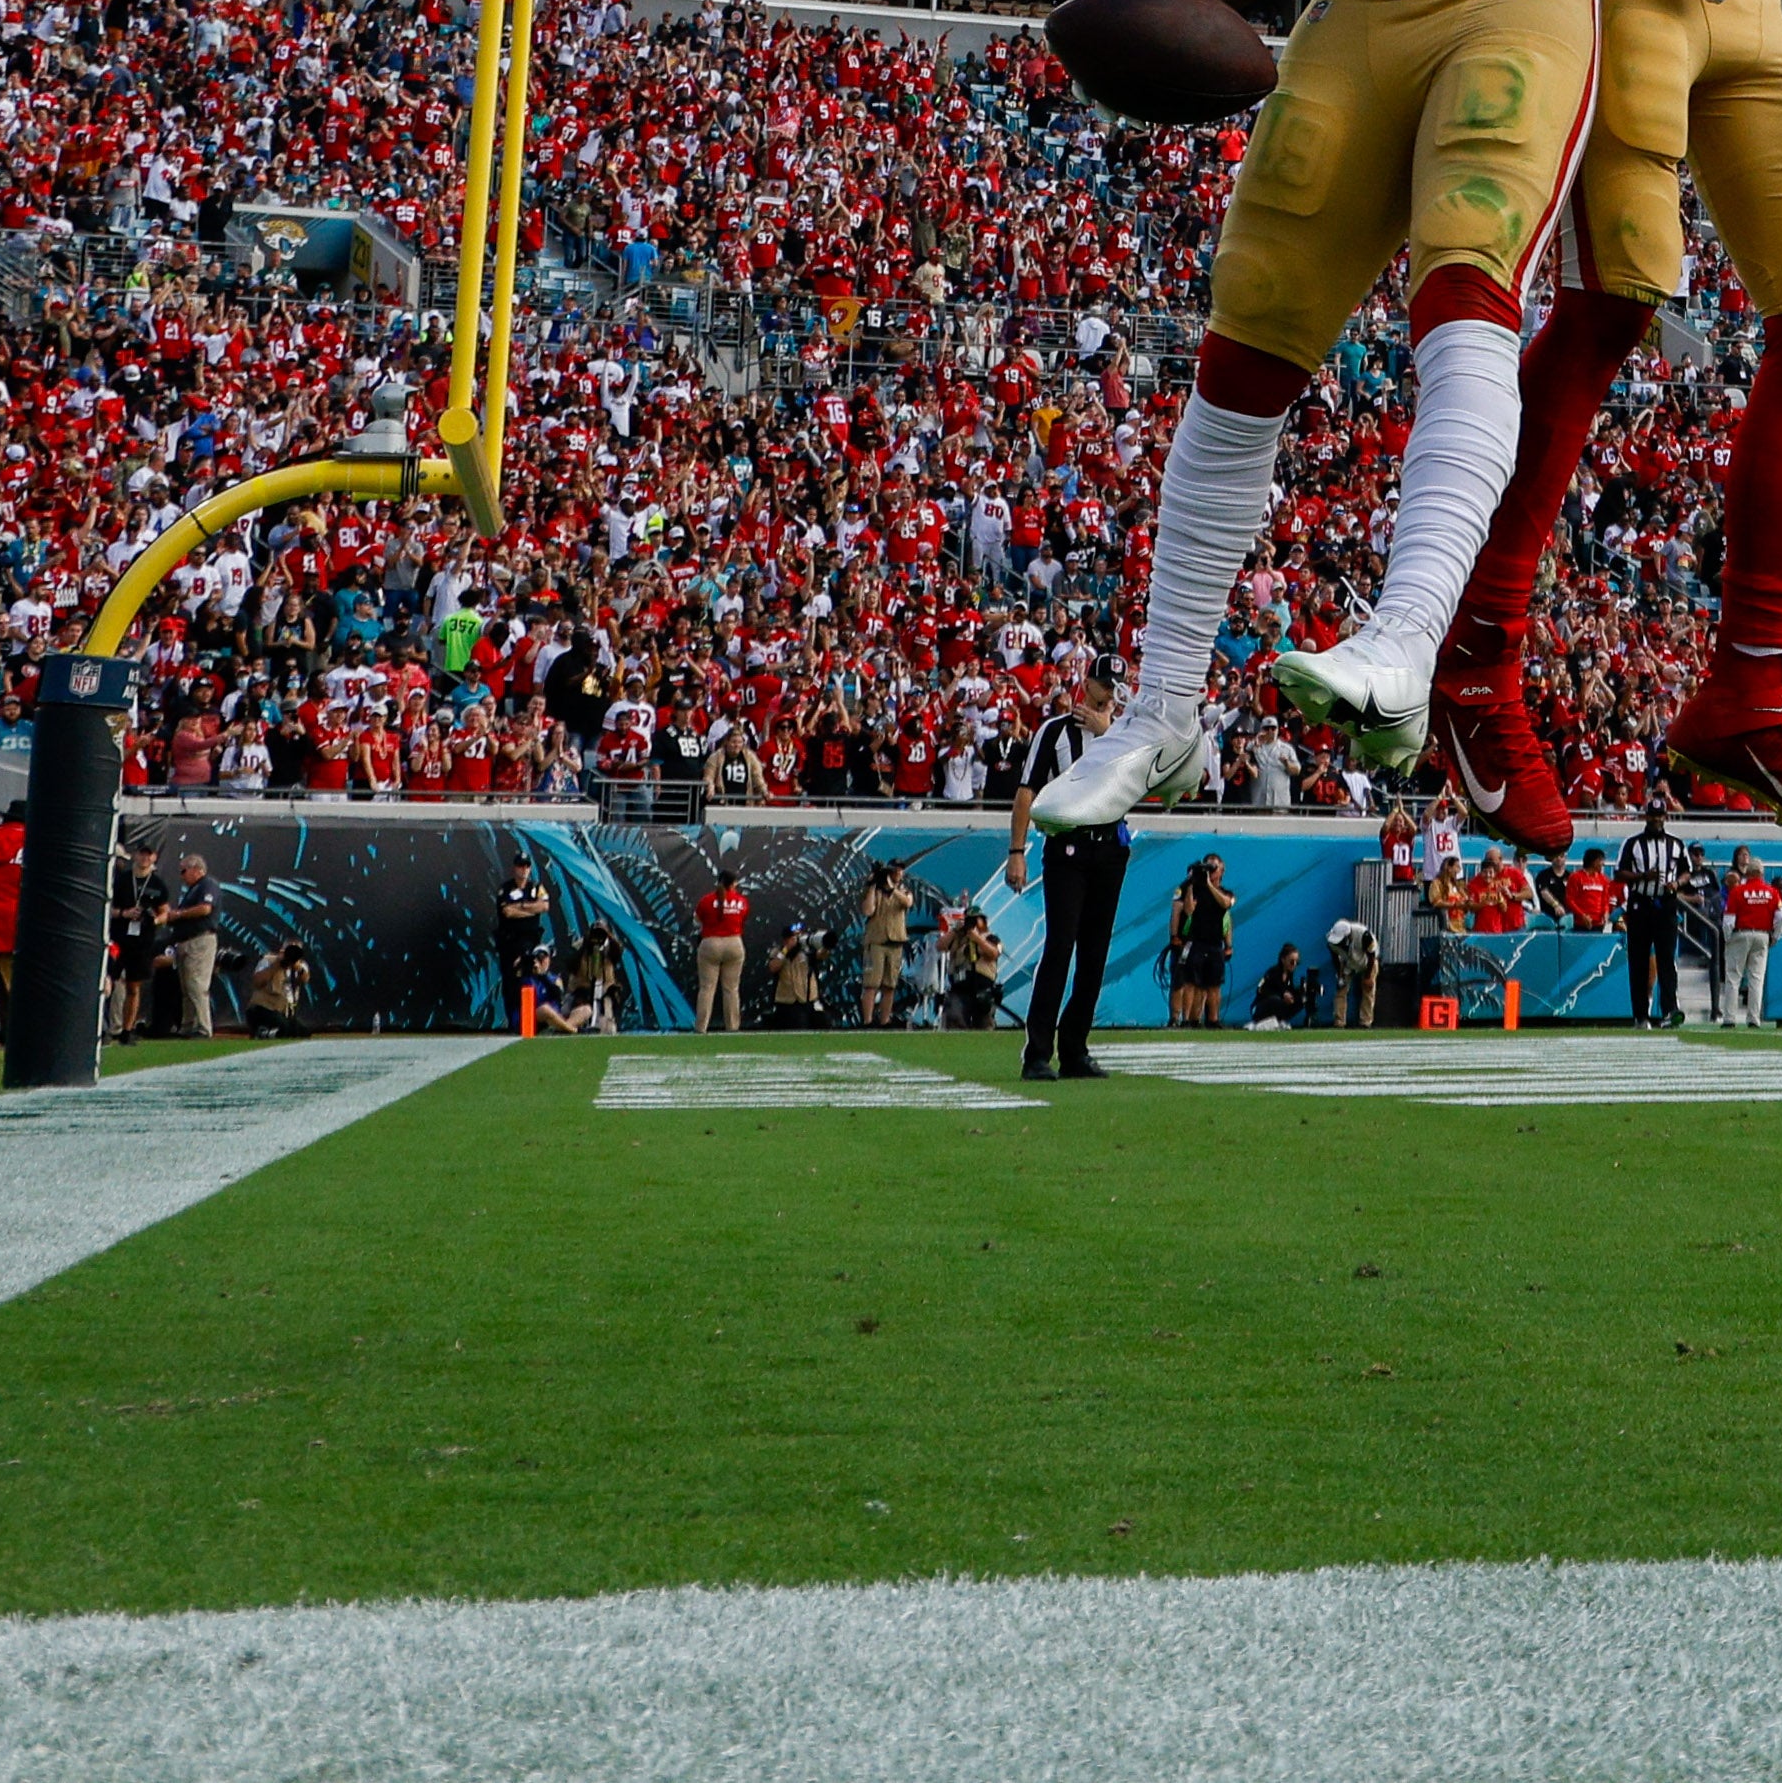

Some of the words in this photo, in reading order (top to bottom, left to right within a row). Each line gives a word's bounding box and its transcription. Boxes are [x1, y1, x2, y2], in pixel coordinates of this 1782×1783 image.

[274, 44, 289, 59] 19
[425, 109, 441, 123] 97
[819, 105, 828, 118] 5
[562, 126, 576, 140] 97
[1168, 150, 1182, 162] 54
[949, 174, 956, 188] 8
[396, 205, 415, 221] 25
[617, 230, 631, 242] 19
[757, 233, 773, 245] 97
[1116, 232, 1128, 247] 19
[866, 310, 881, 326] 16
[164, 323, 180, 342] 21
[268, 339, 284, 357] 16
[1003, 370, 1019, 383] 19
[353, 412, 363, 429] 8
[829, 403, 844, 423] 16
[1600, 447, 1615, 464] 16
[1688, 447, 1702, 460] 13
[1713, 450, 1730, 466] 87
[997, 467, 1007, 480] 7
[984, 502, 1002, 517] 80
[1082, 509, 1100, 525] 42
[901, 522, 917, 538] 85
[450, 618, 476, 635] 357
[742, 689, 755, 705] 10
[1459, 685, 1494, 697] ALPHA
[680, 739, 699, 756] 85
[1581, 744, 1592, 760] 5
[725, 765, 747, 784] 16
[1436, 835, 1452, 850] 85
[1392, 845, 1411, 864] 10
[1431, 1003, 1448, 1026] G
